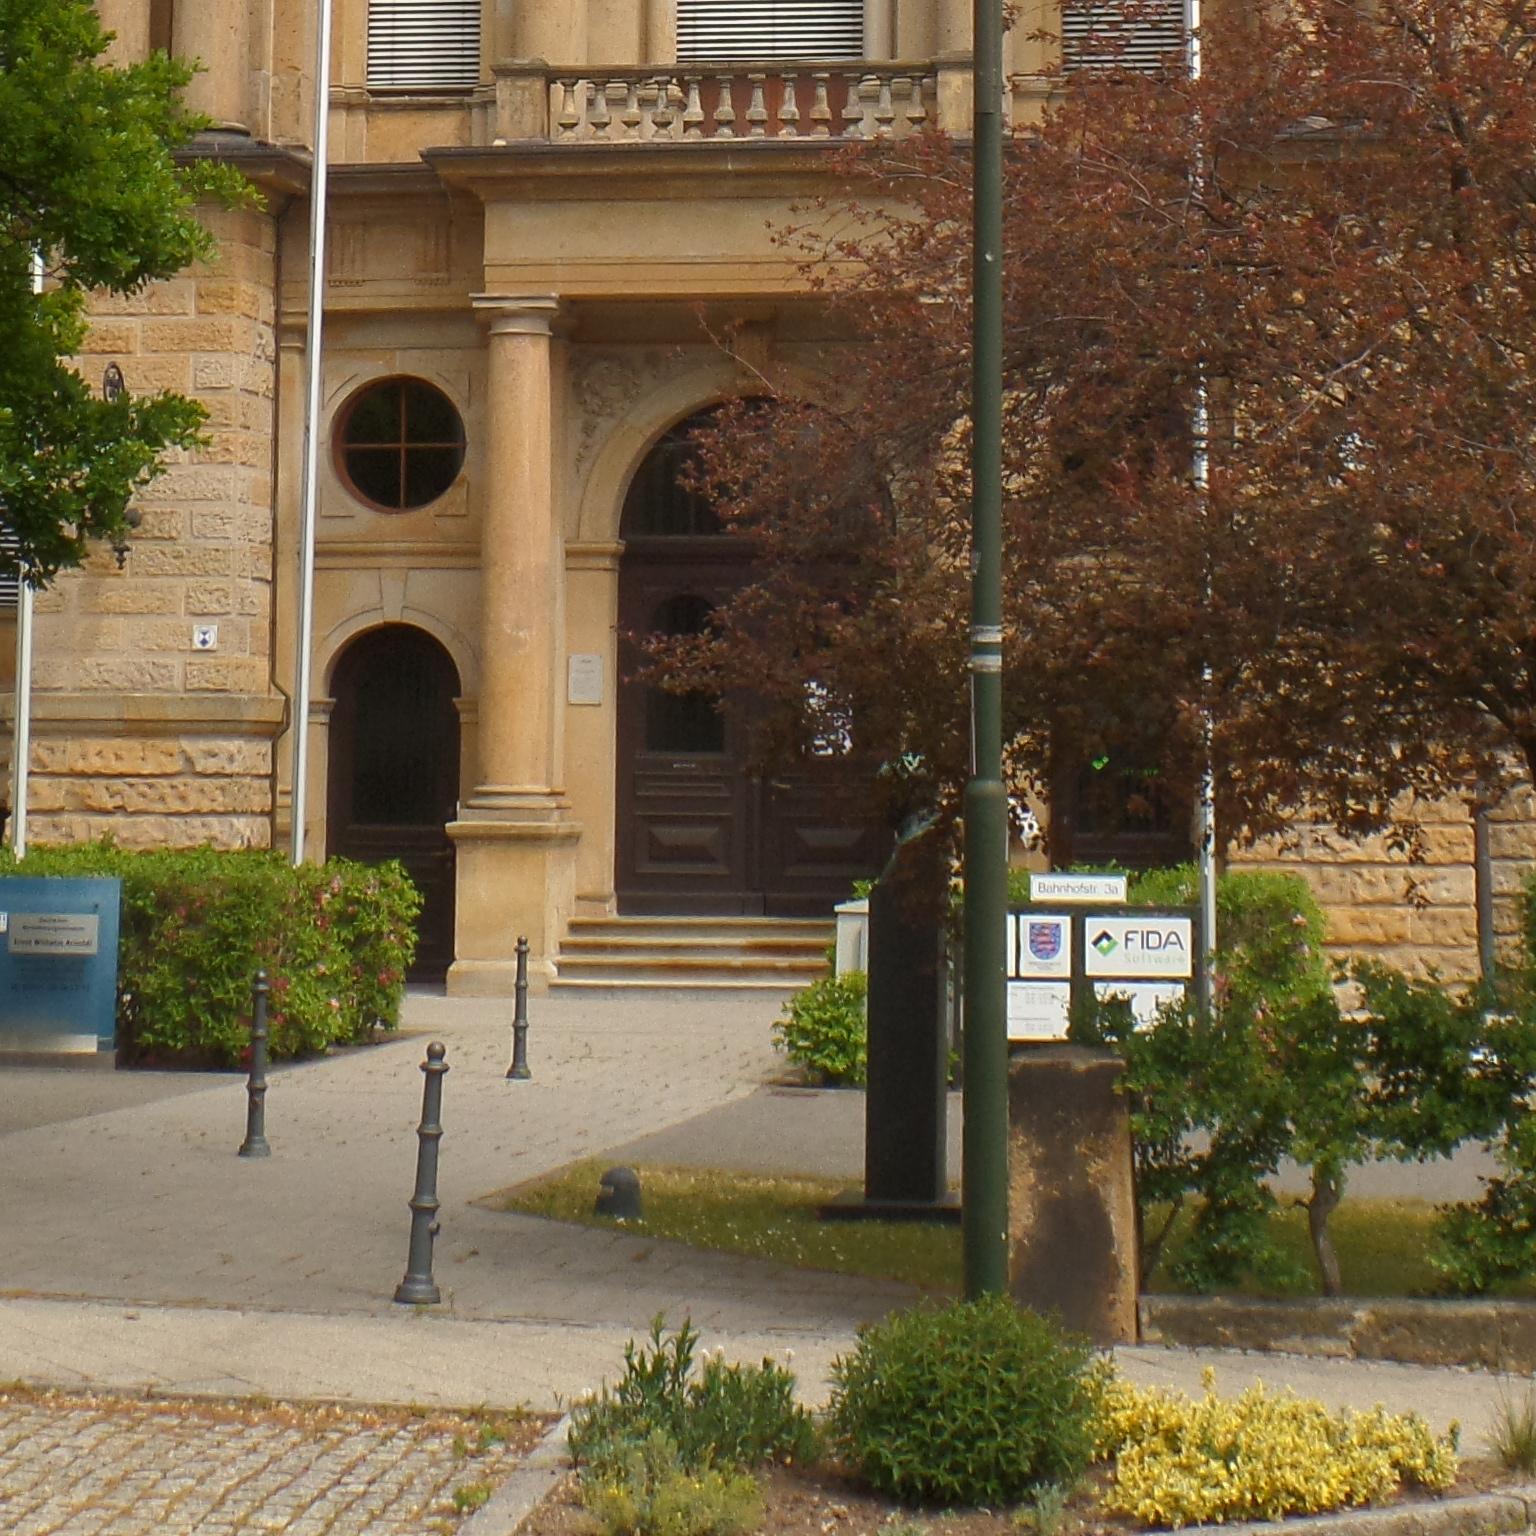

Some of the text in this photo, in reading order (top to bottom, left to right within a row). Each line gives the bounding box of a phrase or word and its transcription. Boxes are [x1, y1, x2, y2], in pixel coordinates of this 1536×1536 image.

[1104, 883, 1119, 895] 3a
[1124, 929, 1185, 951] FIDA
[1124, 952, 1186, 964] Software
